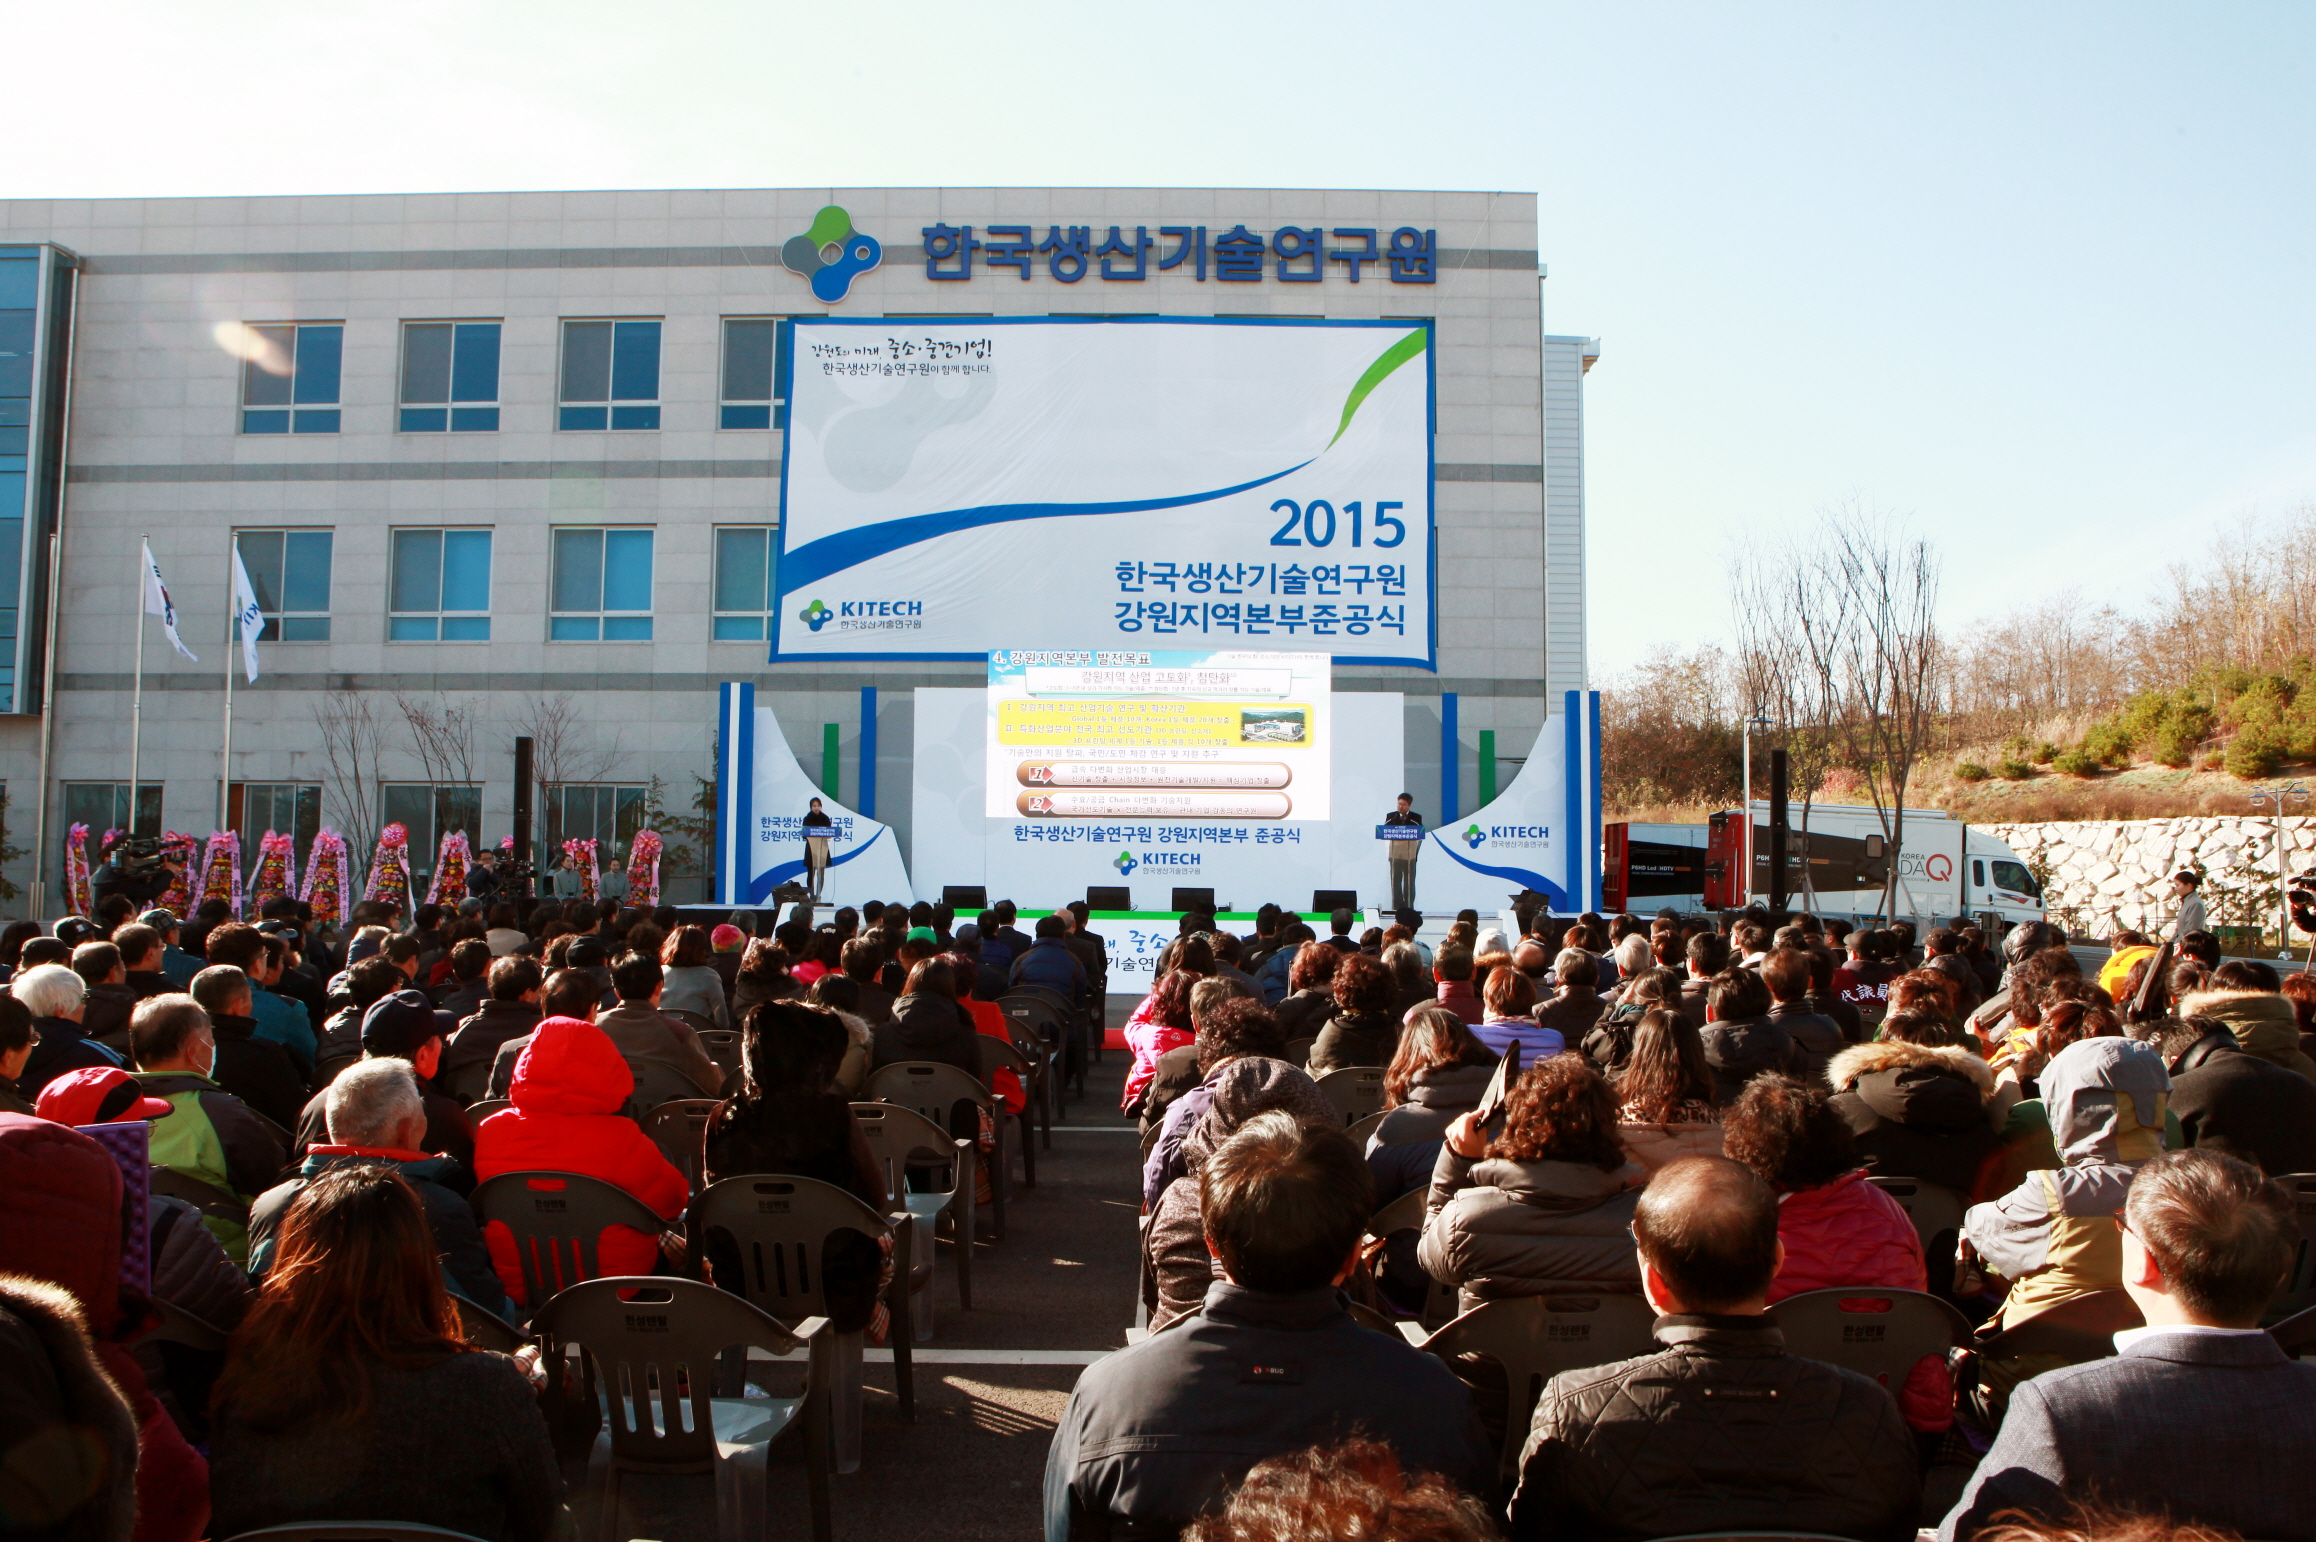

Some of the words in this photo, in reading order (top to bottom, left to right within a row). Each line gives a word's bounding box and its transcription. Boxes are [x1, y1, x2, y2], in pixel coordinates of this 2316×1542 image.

[923, 222, 1437, 284] 한국생산기술연구원
[823, 363, 939, 376] 한국생산기술연구원이
[942, 364, 960, 376] 함께
[1269, 498, 1406, 549] 2015
[1115, 561, 1406, 597] 한국생산기술연구원
[841, 601, 922, 617] KITECH
[841, 619, 922, 630] 한국생산기술연구원
[1114, 600, 1406, 636] 강원지역본부준공식
[993, 652, 1006, 664] 4.
[1011, 652, 1092, 666] 강원지역본부
[1098, 652, 1151, 666] 발전목표
[1082, 671, 1125, 684] 강원지역
[1130, 671, 1150, 684] 산업
[1034, 769, 1042, 780] 1
[1033, 798, 1043, 809] 2
[761, 816, 853, 829] 한국생산구원
[1014, 826, 1151, 842] 한국생산기술연구원
[1157, 827, 1248, 843] 강원지역본부
[1254, 828, 1300, 843] 준공식
[1491, 826, 1549, 838] KITECH
[1143, 853, 1201, 865] KITECH
[1143, 867, 1201, 875] 한국생산기술연구원
